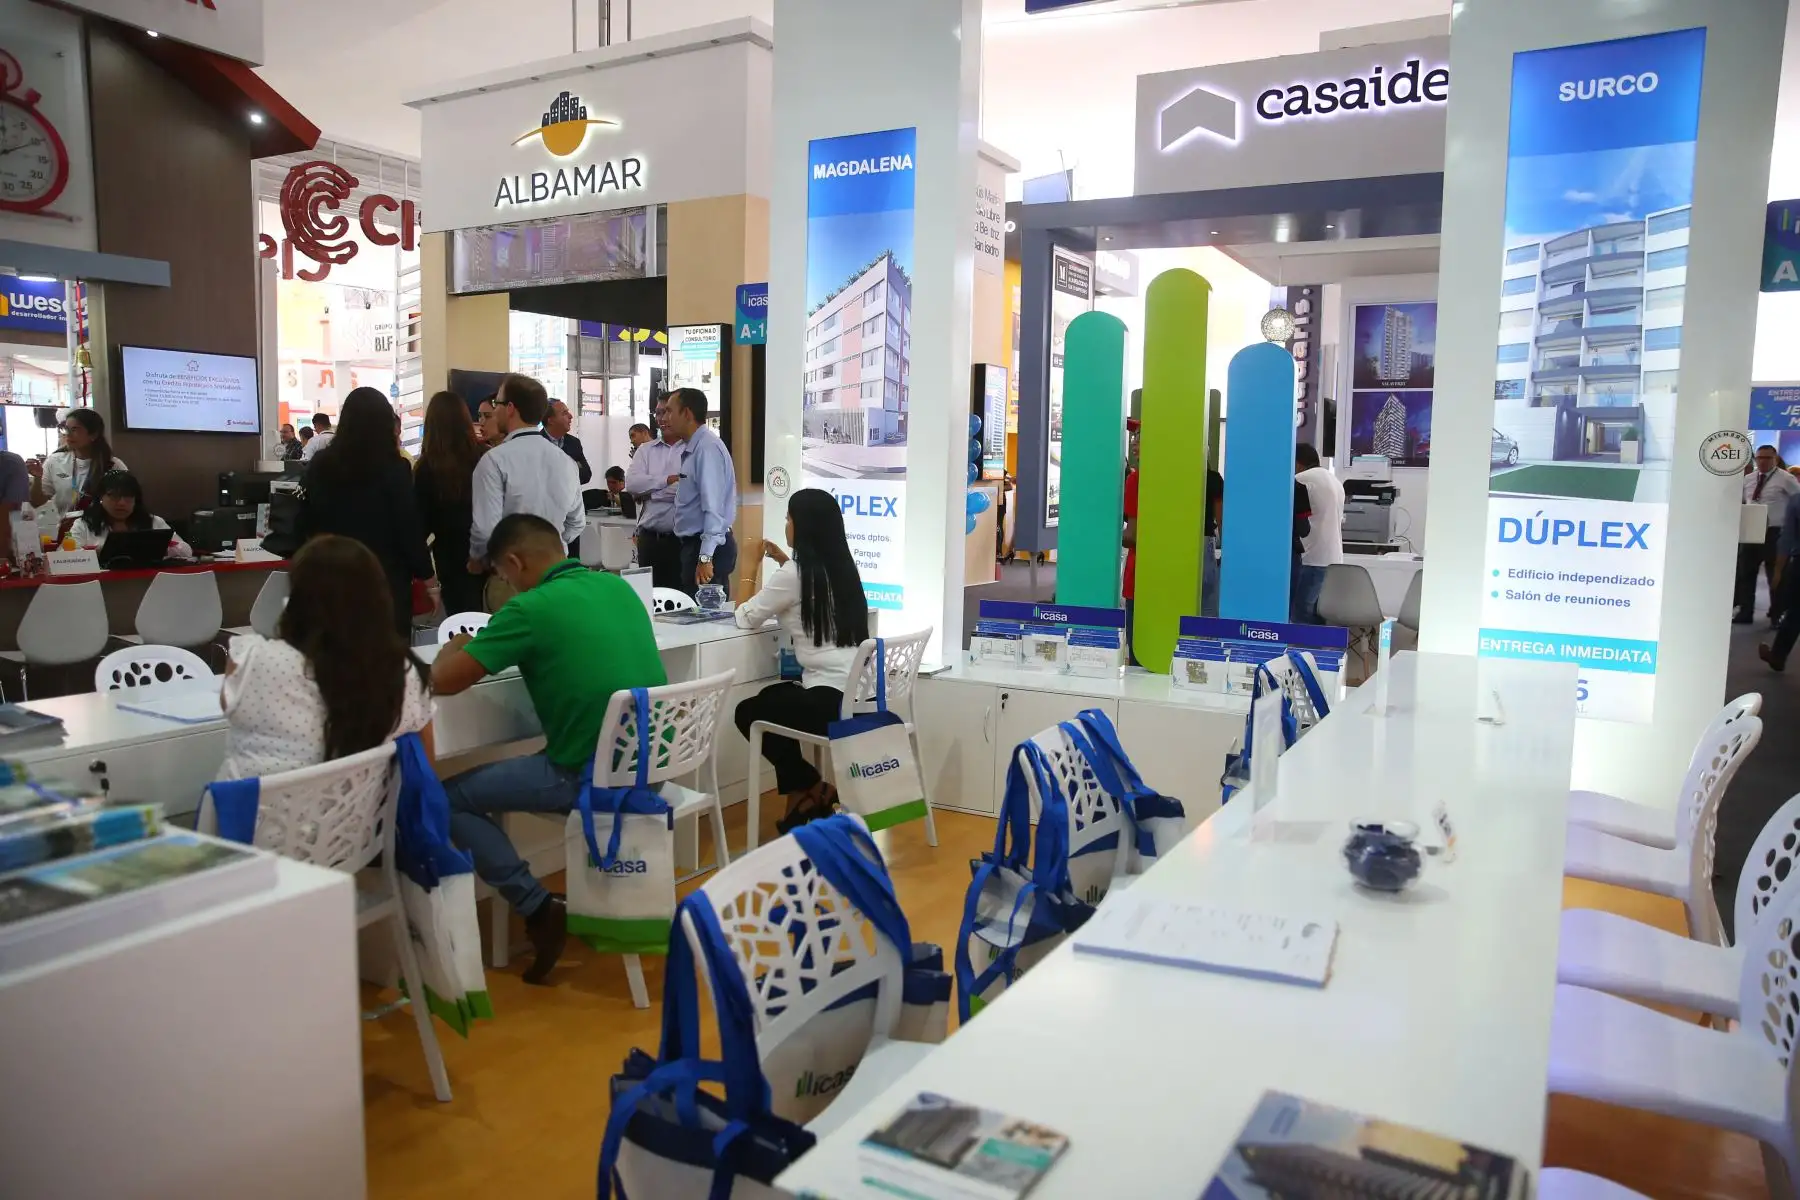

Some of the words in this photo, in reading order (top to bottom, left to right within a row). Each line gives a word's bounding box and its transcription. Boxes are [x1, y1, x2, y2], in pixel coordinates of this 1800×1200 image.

[1256, 59, 1449, 120] casaide
[1559, 72, 1659, 102] SURCO
[813, 153, 913, 180] MAGDALENA
[494, 158, 642, 208] ALBAMAR
[359, 194, 421, 251] CI
[740, 323, 767, 339] A-1
[374, 336, 393, 352] BLF
[1780, 405, 1800, 416] JE
[1707, 432, 1746, 443] MIEMBRO
[1710, 449, 1741, 460] ASEI
[1498, 510, 1650, 550] DÚPLEX
[854, 548, 881, 559] Parque
[856, 560, 878, 569] Prada
[1507, 568, 1555, 581] Edificio
[1558, 570, 1655, 587] independizado
[1505, 589, 1541, 602] Salón
[1545, 591, 1561, 603] de
[1565, 594, 1631, 608] reuniones
[1040, 612, 1068, 622] icasa
[1247, 629, 1279, 641] icasa
[1480, 637, 1556, 656] ENTREGA
[1560, 643, 1652, 665] INMEDIATA
[861, 756, 900, 778] icasa
